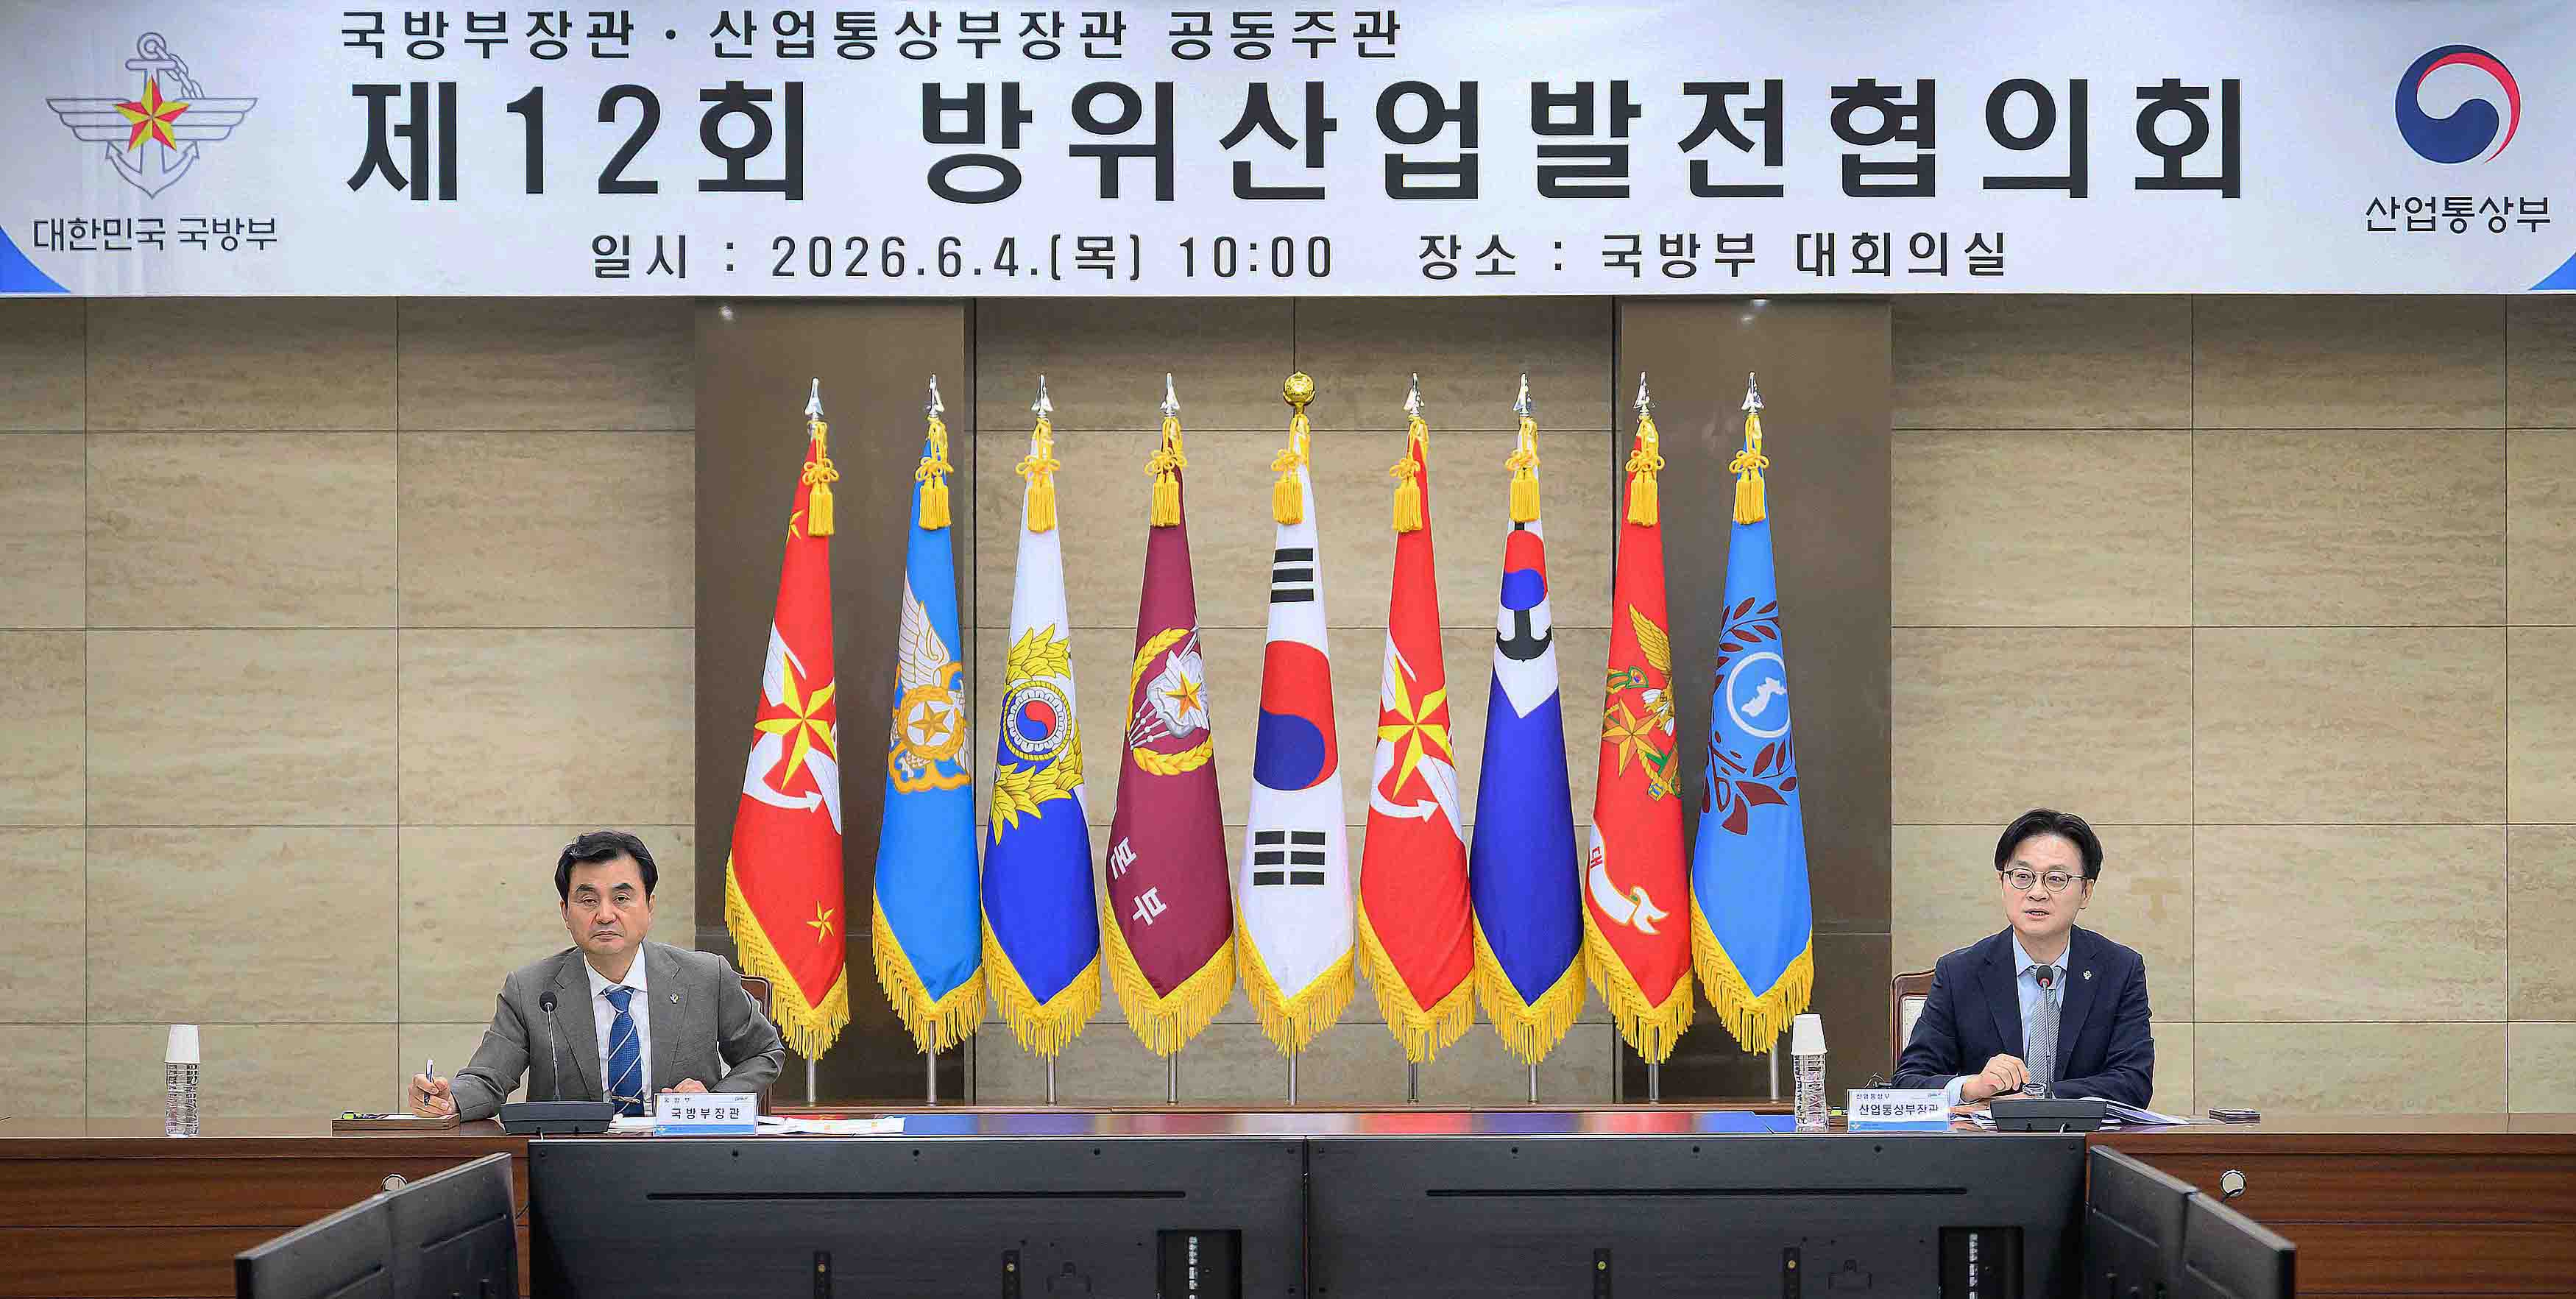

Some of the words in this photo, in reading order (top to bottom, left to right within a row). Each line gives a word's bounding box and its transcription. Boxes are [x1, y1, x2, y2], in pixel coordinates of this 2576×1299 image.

[342, 10, 635, 61] 국방부장관
[709, 10, 1128, 61] 산업통상부장관
[1169, 10, 1402, 61] 공동주관
[347, 81, 805, 202] 제12회
[922, 78, 2242, 205] 방위산업발전협의회
[32, 218, 166, 252] 대한민국
[178, 218, 278, 252] 국방부
[2365, 196, 2552, 235] 산업통상부
[592, 235, 687, 280] 일시
[1180, 236, 1332, 279] 10:00
[1418, 234, 1517, 281] 장소
[1602, 233, 1757, 280] 국방부
[1797, 233, 2006, 278] 대회의실
[671, 1108, 740, 1119] 국방부장관
